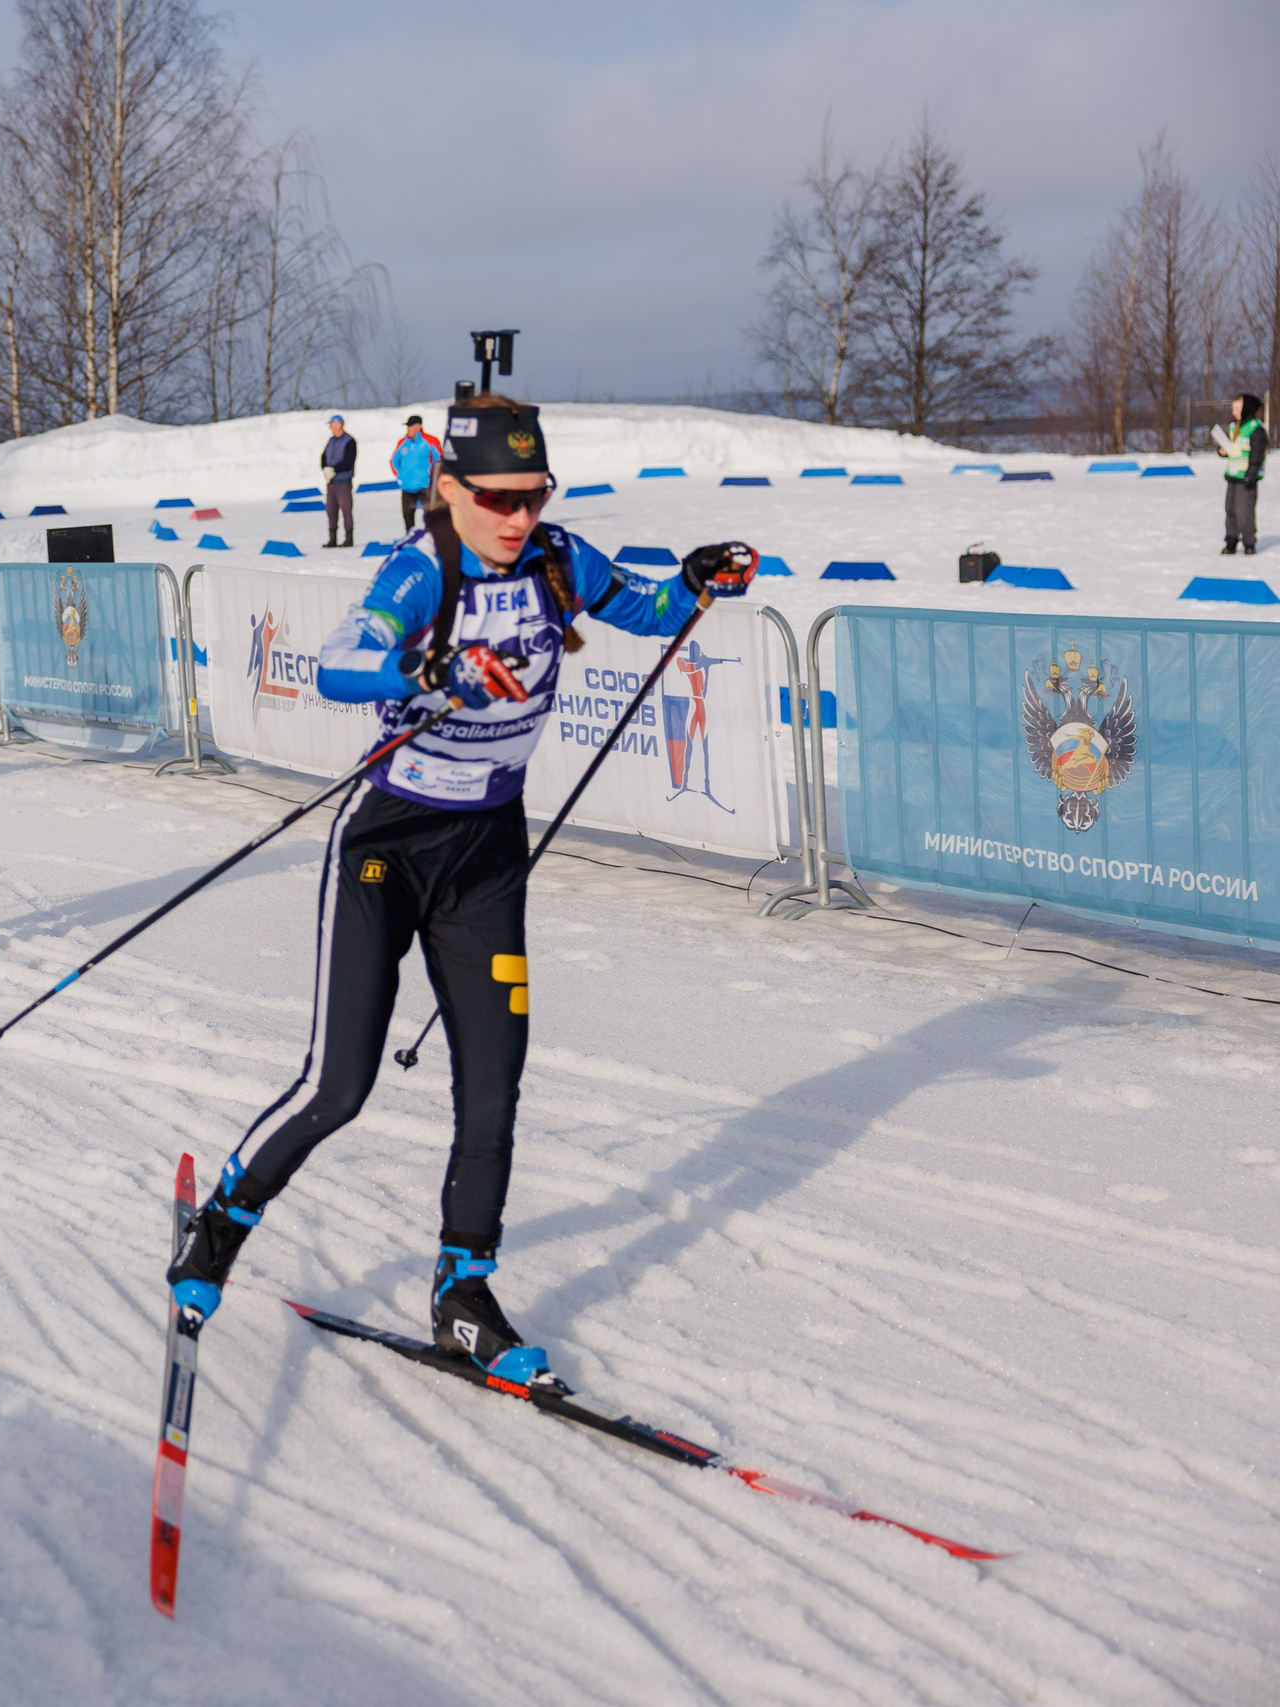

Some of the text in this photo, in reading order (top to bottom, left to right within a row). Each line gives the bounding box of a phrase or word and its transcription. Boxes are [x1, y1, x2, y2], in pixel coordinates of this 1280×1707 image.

[99, 685, 133, 698] РОССИИ
[924, 831, 1259, 902] МИНИСТЕРСТВО СПОРТА РОССИИ
[486, 1374, 531, 1400] ATOMIC
